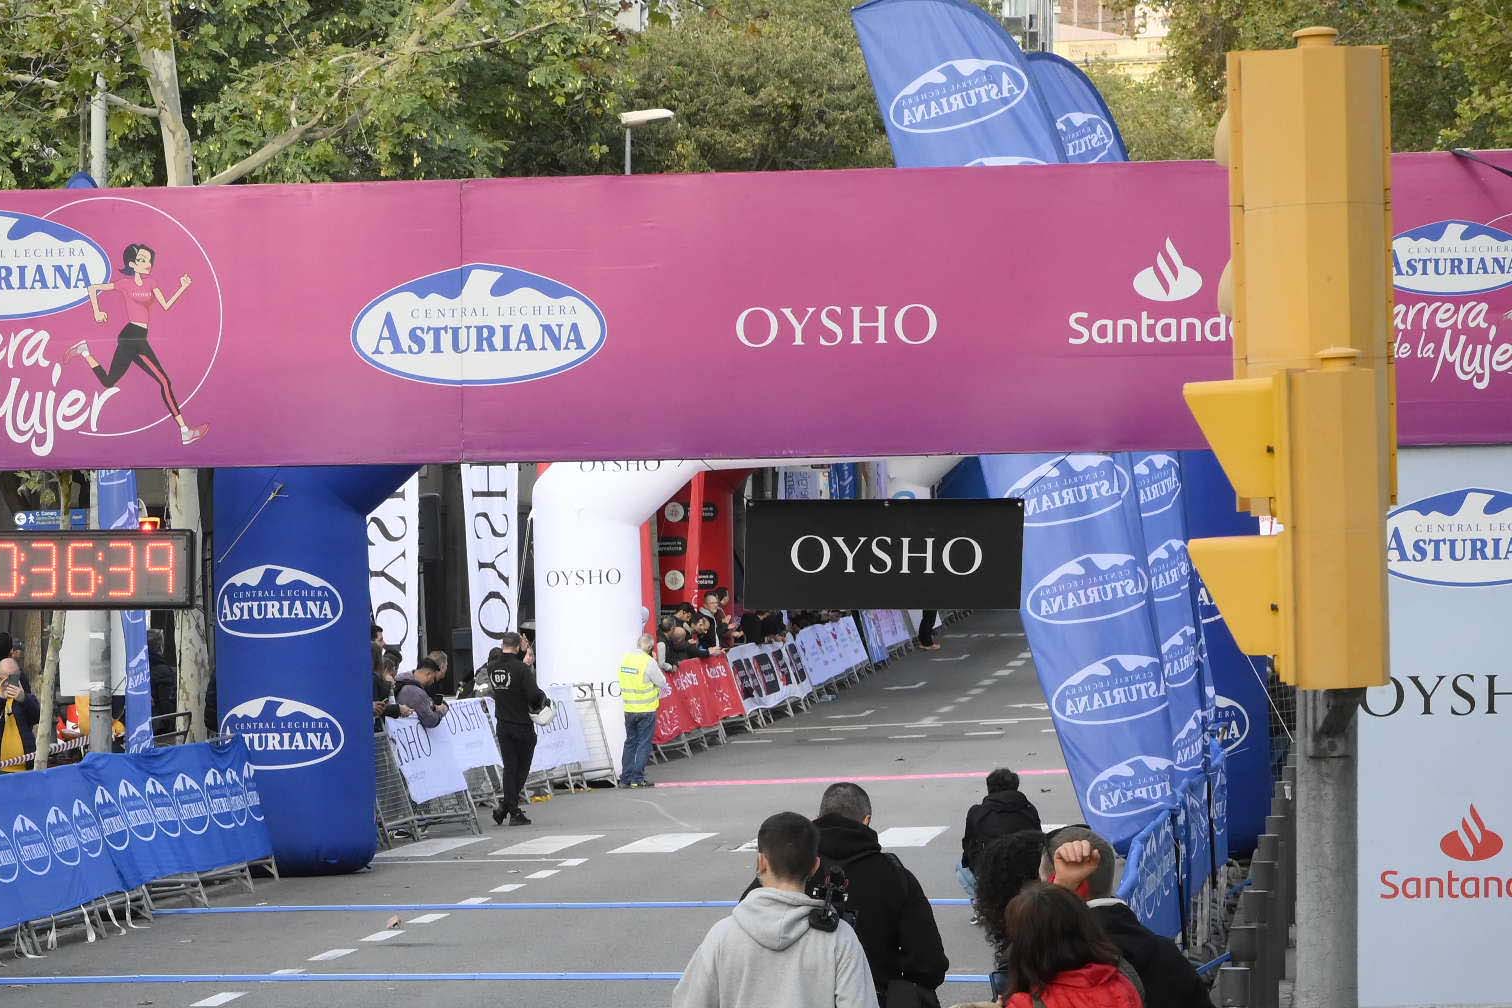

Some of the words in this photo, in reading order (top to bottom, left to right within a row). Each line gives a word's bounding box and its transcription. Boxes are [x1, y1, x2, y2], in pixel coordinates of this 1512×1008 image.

[14, 247, 86, 258] LECHERA
[1408, 246, 1459, 254] CENTRAL
[1465, 245, 1512, 254] LECHER
[411, 307, 489, 319] CENTRAL
[498, 305, 577, 318] LECHERA
[1393, 301, 1489, 330] arrera
[372, 311, 586, 356] ASTURIANA
[736, 303, 938, 347] OYSHO
[1069, 311, 1233, 345] Santand
[1418, 331, 1435, 358] la
[1431, 328, 1512, 390] Muje
[1415, 523, 1481, 533] CENTRAL
[790, 535, 984, 575] OYSHO
[546, 567, 622, 588] OYSHO
[234, 590, 274, 598] CENTRAL
[280, 589, 329, 597] LECHERA
[221, 594, 333, 621] ASTURIANA
[495, 674, 506, 683] BP
[577, 680, 622, 698] SHO
[235, 721, 275, 730] CENTRAL
[280, 720, 329, 729] LECHERA
[225, 726, 333, 751] TURIANA
